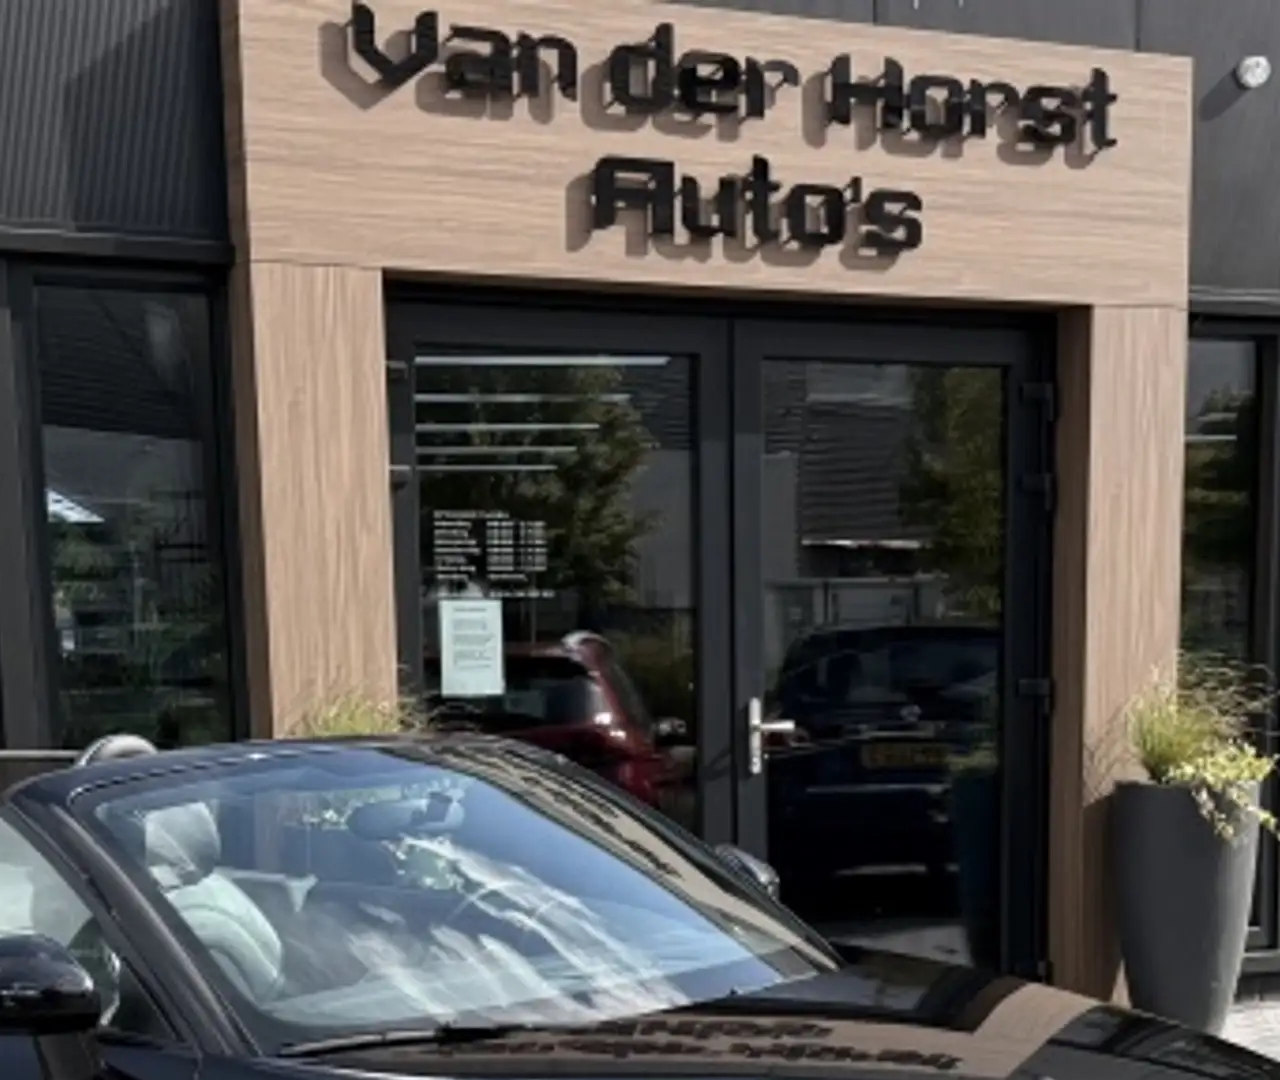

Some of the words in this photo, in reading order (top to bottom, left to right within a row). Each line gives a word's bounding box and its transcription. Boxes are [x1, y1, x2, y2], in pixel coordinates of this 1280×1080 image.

[351, 0, 577, 101] Van
[609, 22, 800, 119] der
[828, 53, 1118, 148] Horst
[591, 155, 923, 255] Auto's
